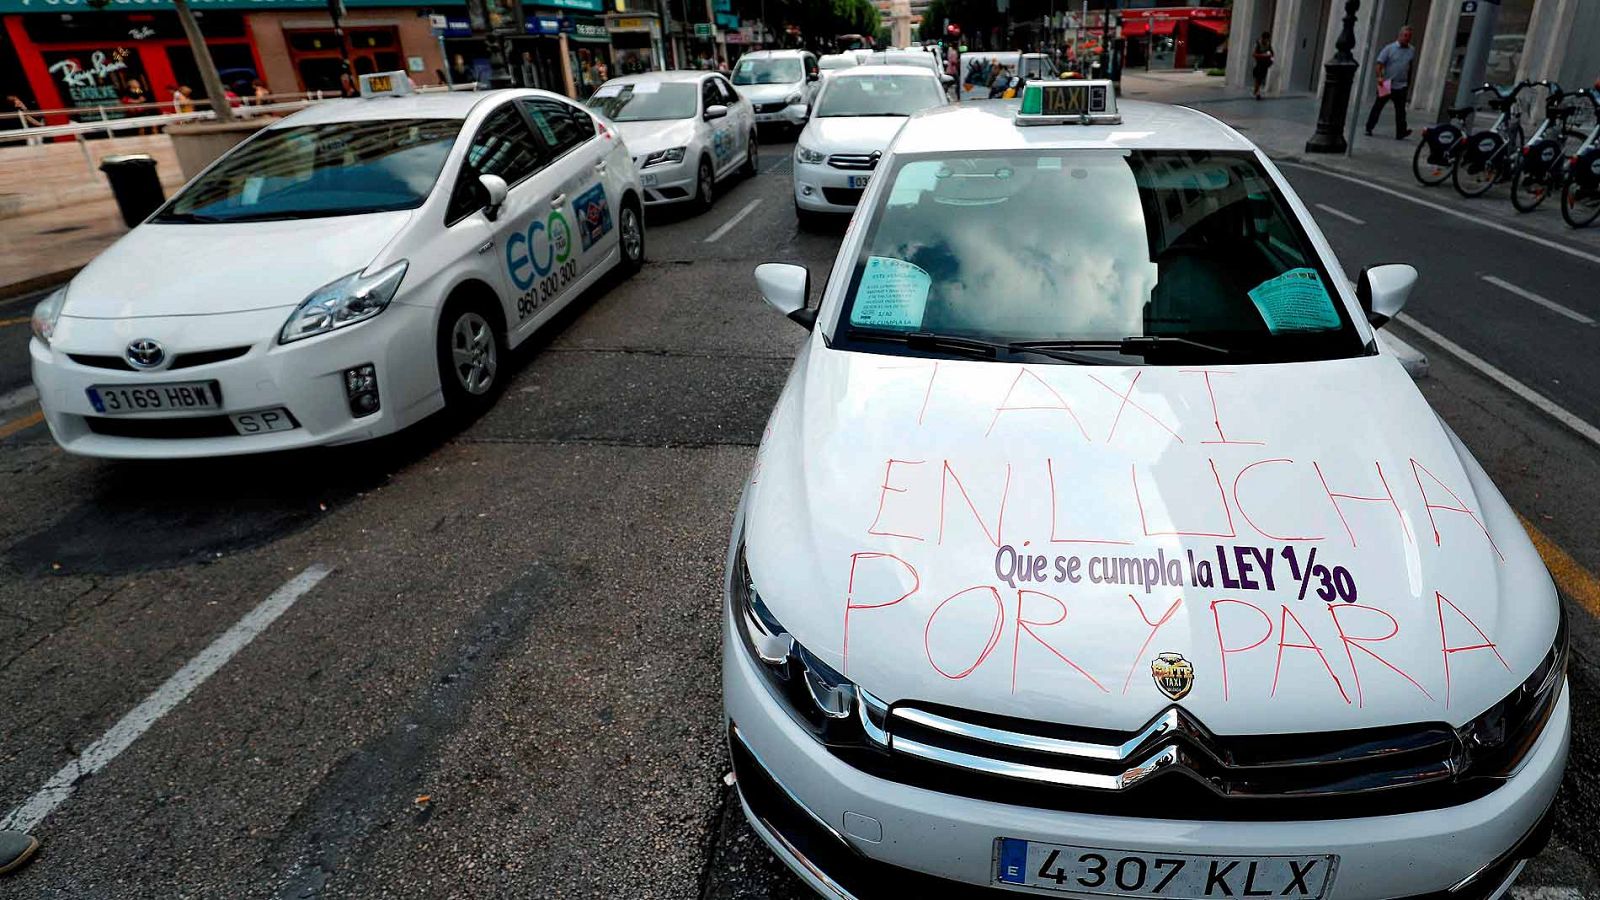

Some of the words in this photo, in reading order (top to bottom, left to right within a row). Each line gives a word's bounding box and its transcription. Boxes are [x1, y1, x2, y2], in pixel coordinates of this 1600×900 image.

[1047, 87, 1086, 110] TAXI
[517, 288, 538, 319] 960
[540, 273, 557, 302] 300
[560, 259, 577, 287] 300
[105, 389, 161, 410] 3169
[164, 386, 210, 408] HBW
[877, 362, 1266, 446] TAXI
[1054, 555, 1081, 584] se
[1089, 548, 1184, 594] cumpla
[1187, 549, 1214, 589] la
[1216, 546, 1276, 592] LEY
[1281, 545, 1358, 604] 1/30
[843, 552, 1111, 695] POR
[1122, 593, 1183, 695] Y
[1209, 591, 1513, 711] PARA
[1165, 678, 1181, 687] TAXI
[1007, 866, 1019, 877] E
[1038, 849, 1187, 894] 4307
[1204, 859, 1319, 897] KLX
